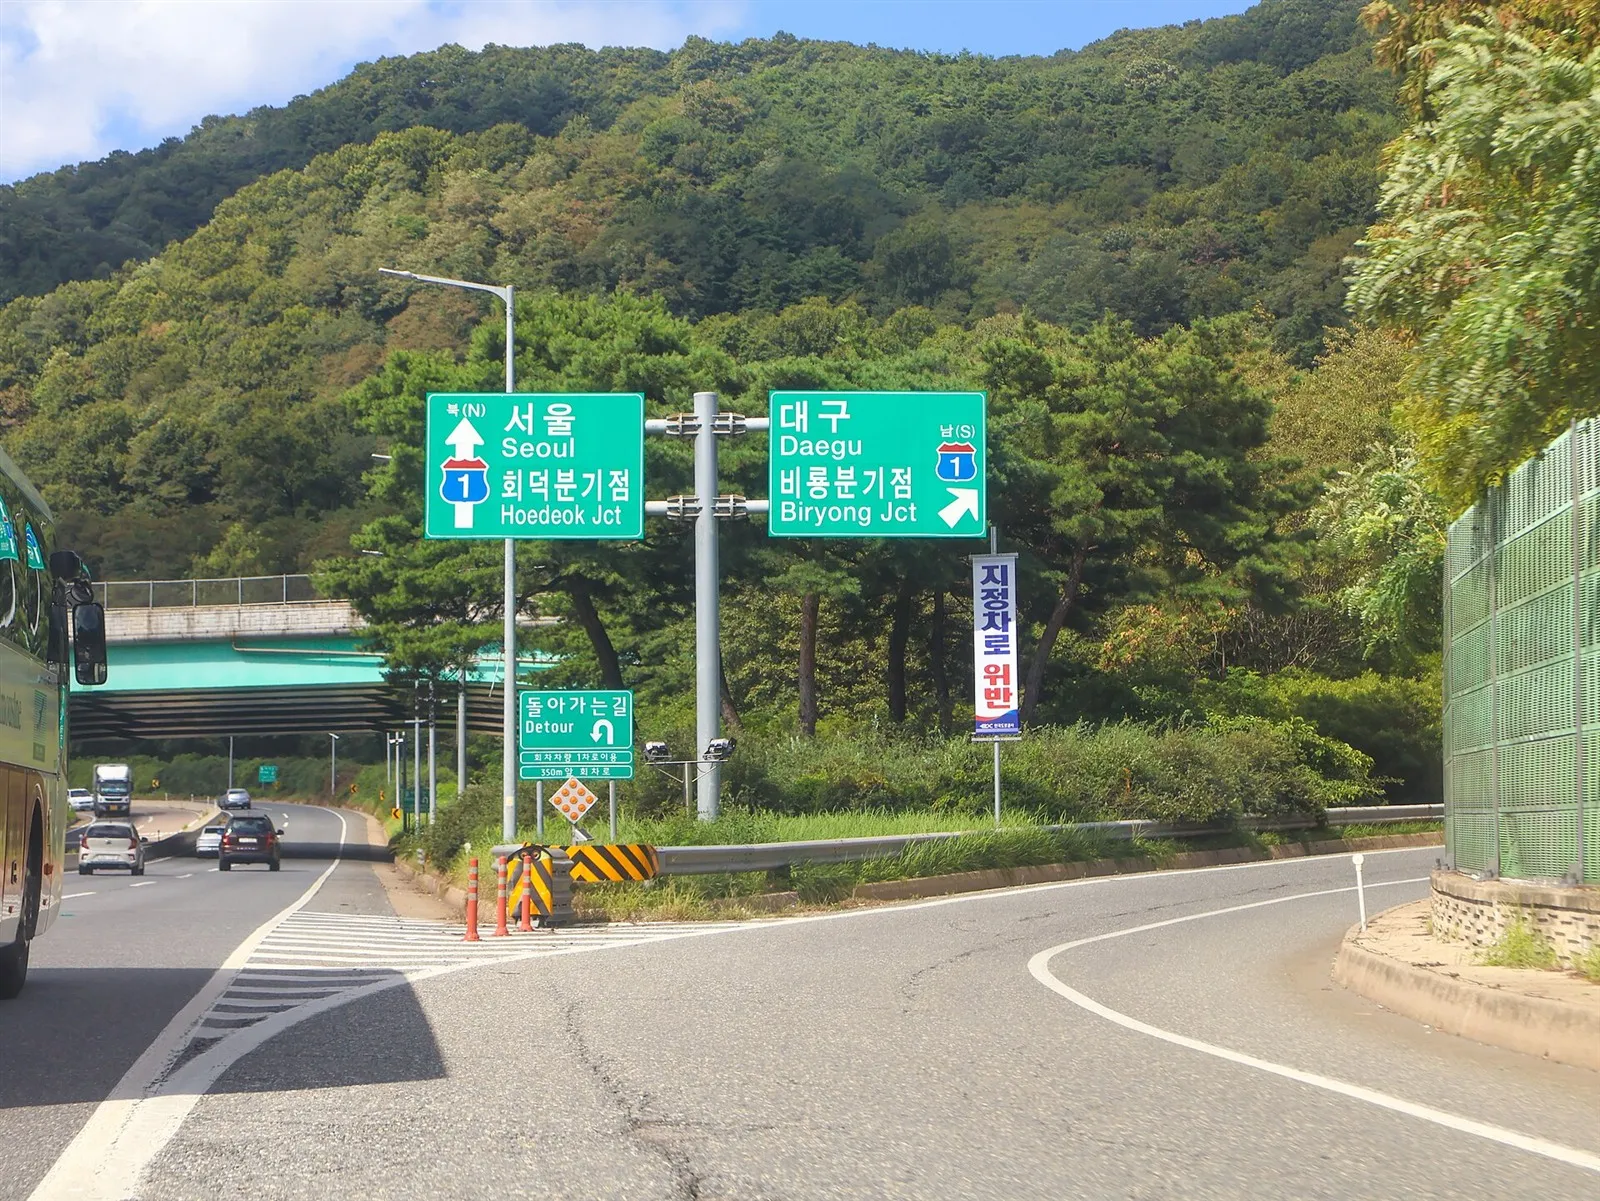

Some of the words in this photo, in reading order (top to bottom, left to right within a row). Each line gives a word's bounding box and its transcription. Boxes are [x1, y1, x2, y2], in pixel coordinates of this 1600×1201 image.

[504, 402, 575, 437] 서울
[780, 400, 851, 434] 대구
[501, 437, 575, 458] Seoul
[780, 435, 862, 461] Daegu
[949, 456, 960, 477] 1
[457, 473, 469, 498] 1
[501, 468, 630, 502] 회덕분기점
[780, 465, 912, 500] 비룡분기점
[501, 504, 586, 525] Hoedeok
[591, 504, 622, 525] Jct
[781, 501, 872, 527] Biryong
[880, 501, 917, 523] Jct
[980, 564, 1012, 656] 지정차로
[983, 663, 1013, 710] 위반
[525, 696, 627, 718] 돌아가는길
[525, 720, 574, 734] Detour
